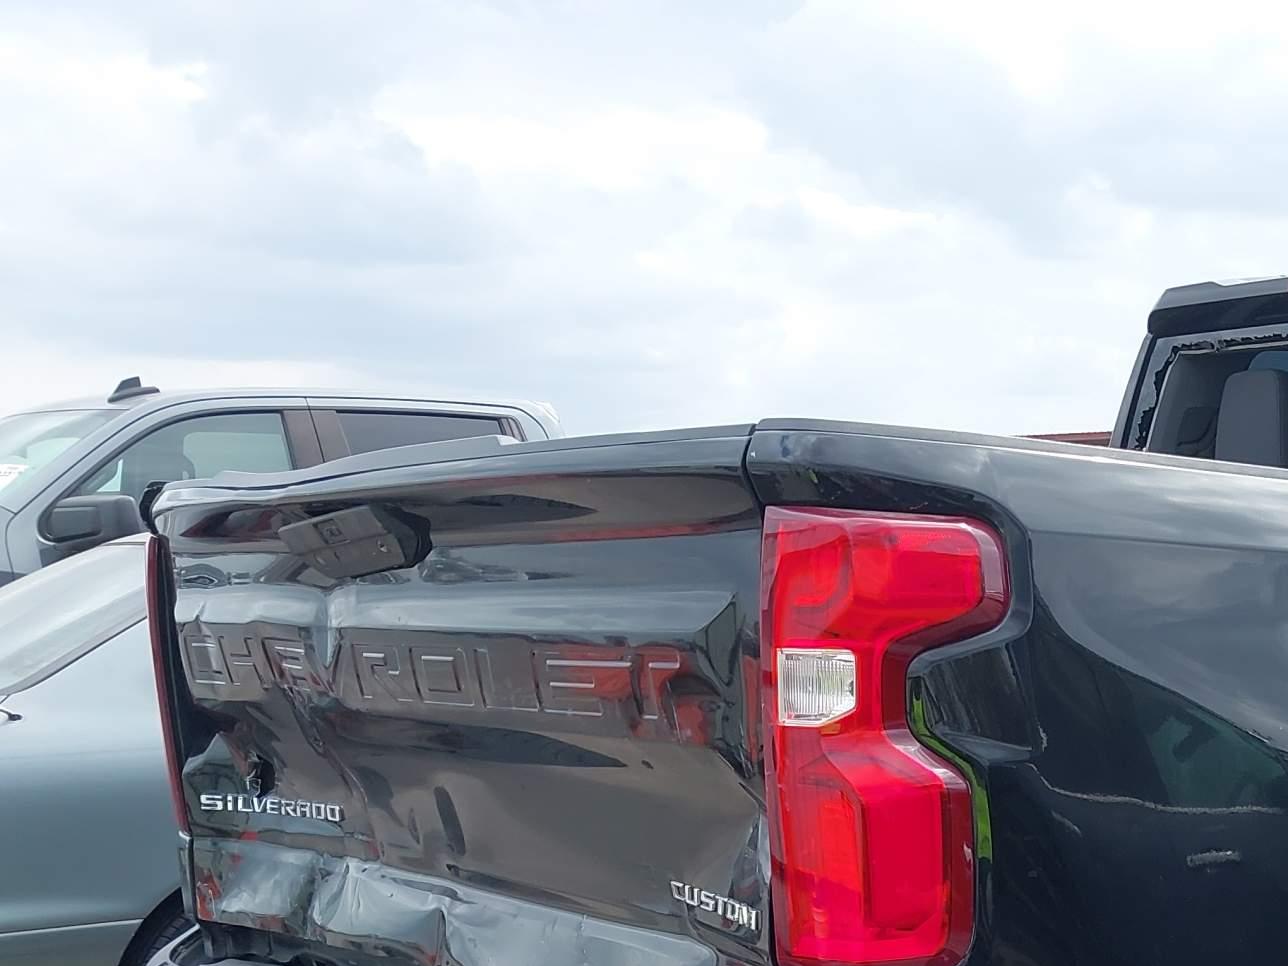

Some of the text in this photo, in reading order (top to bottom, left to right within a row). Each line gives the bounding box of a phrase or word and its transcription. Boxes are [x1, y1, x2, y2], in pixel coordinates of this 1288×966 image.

[183, 634, 682, 722] CHEVROLET
[199, 793, 344, 823] SILVERADO
[669, 880, 761, 931] CUSTOM
